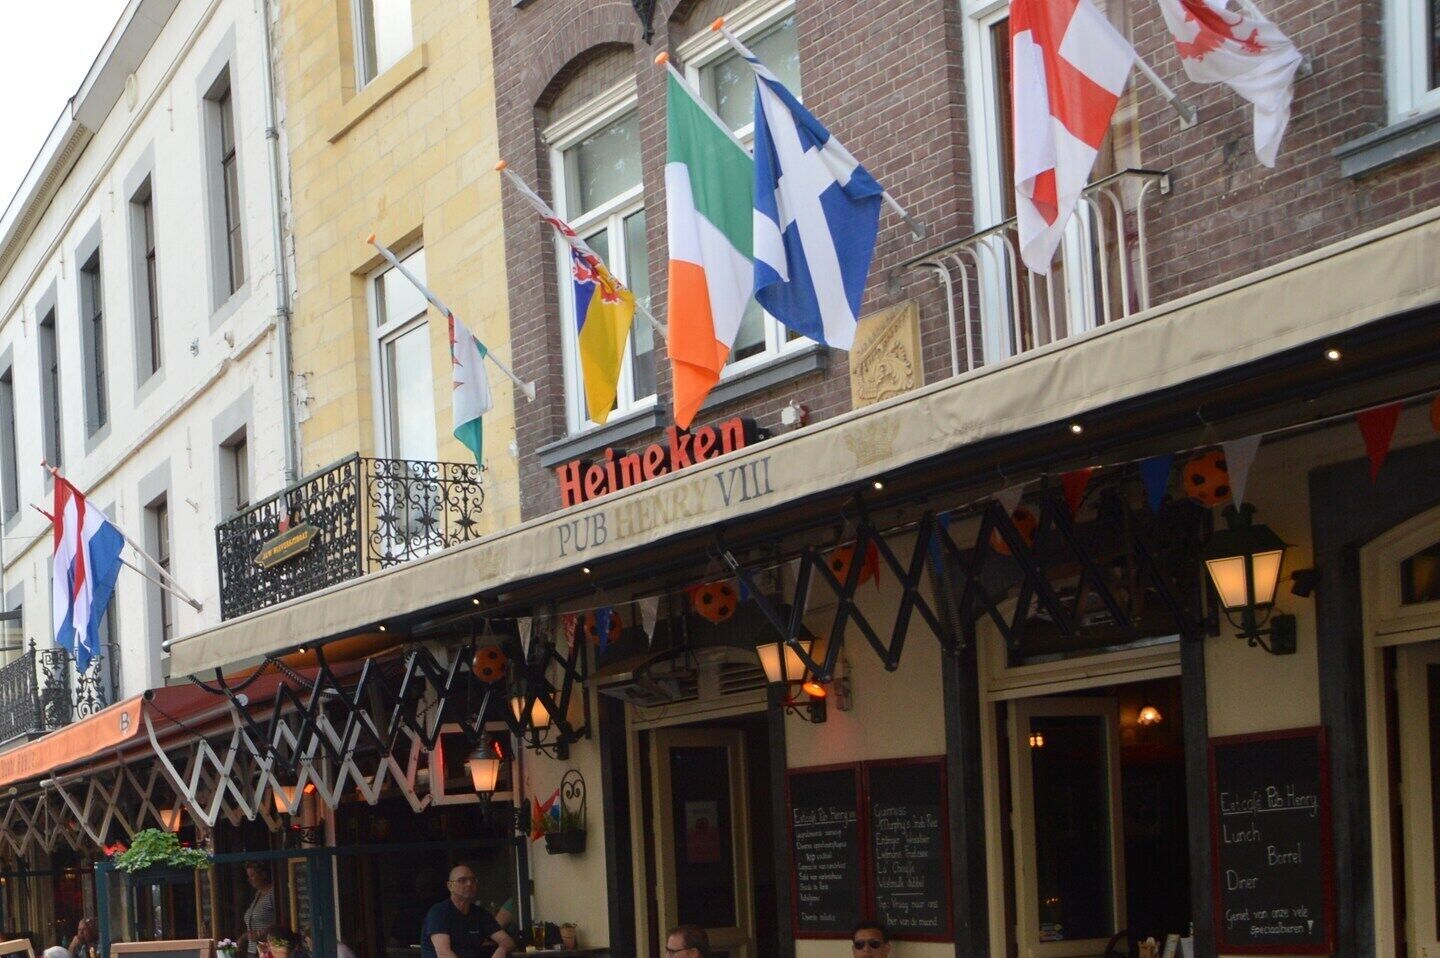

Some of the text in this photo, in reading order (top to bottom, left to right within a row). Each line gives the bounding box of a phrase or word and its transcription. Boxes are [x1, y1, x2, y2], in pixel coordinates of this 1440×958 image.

[556, 416, 747, 508] Heineken
[557, 455, 775, 557] PUB HENRY VIII
[1265, 786, 1283, 808] Pub
[1286, 784, 1319, 817] Henry
[1223, 822, 1261, 843] Lunch
[1267, 842, 1303, 866] Borrel
[1226, 869, 1258, 890] Diner
[1253, 909, 1268, 919] van
